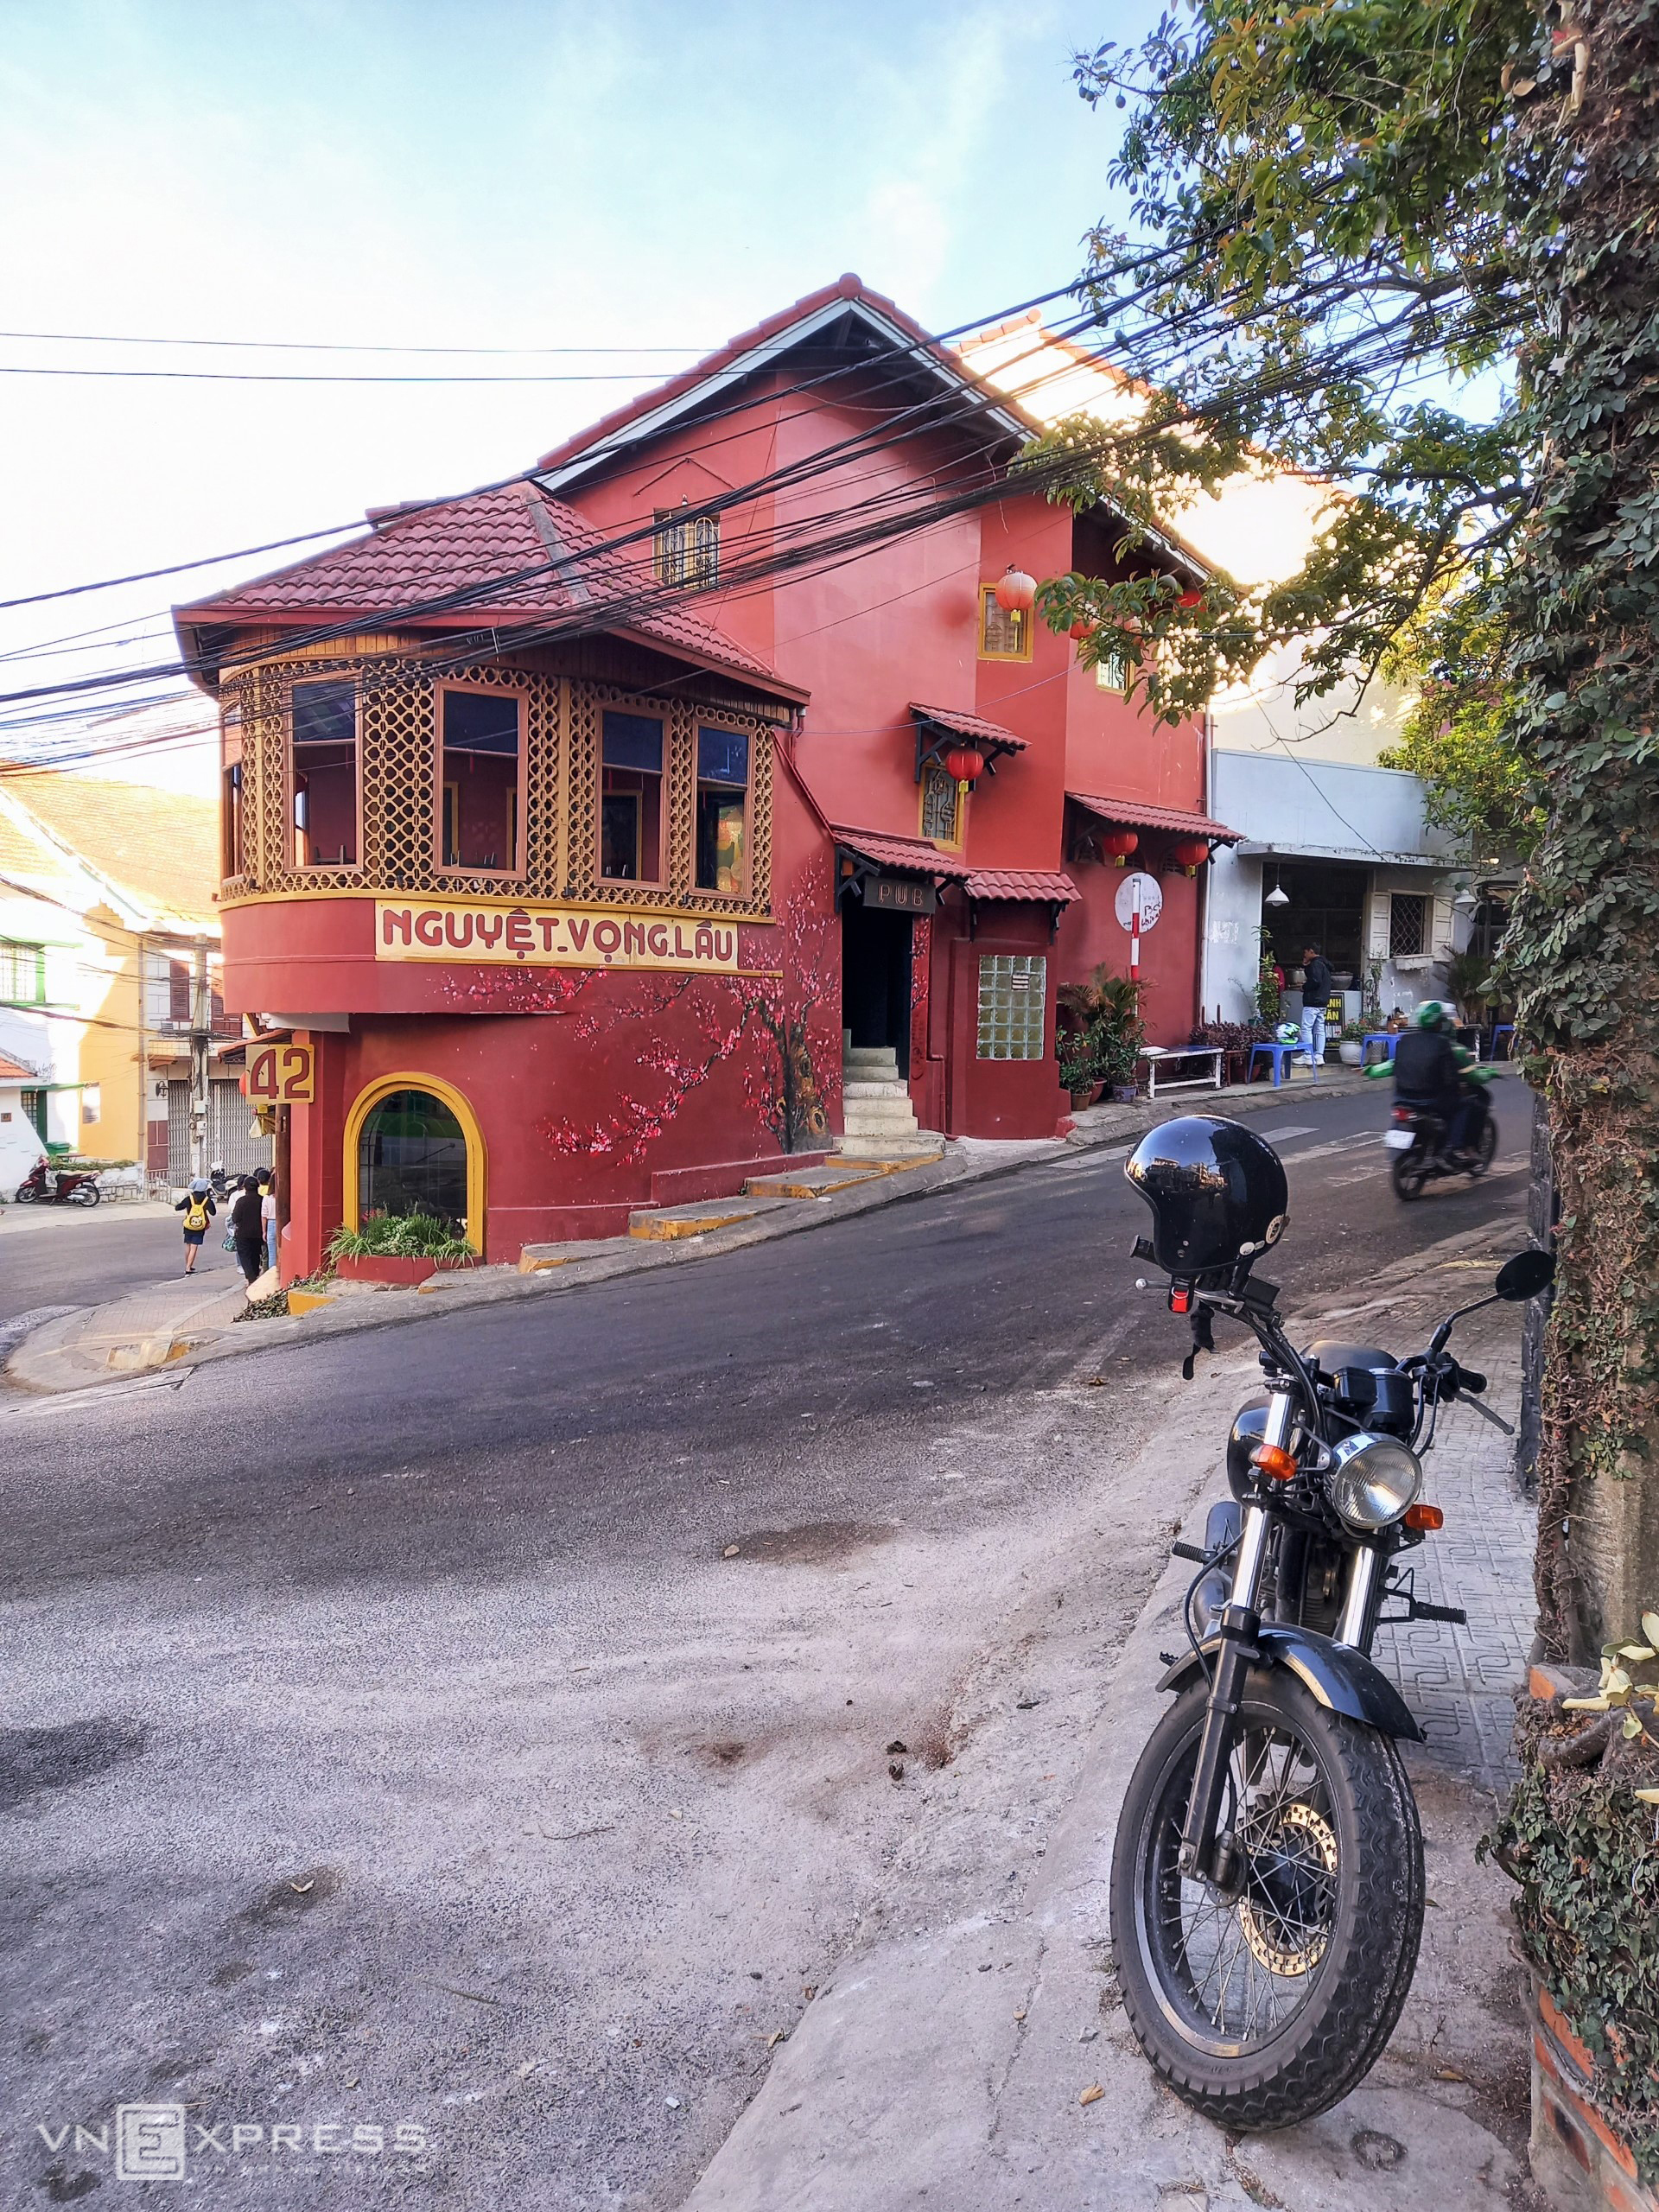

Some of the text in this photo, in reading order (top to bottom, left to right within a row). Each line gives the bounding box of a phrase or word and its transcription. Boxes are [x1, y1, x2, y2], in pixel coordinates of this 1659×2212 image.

[878, 884, 924, 906] PUB
[1326, 998, 1342, 1007] NH
[250, 1047, 310, 1099] 42
